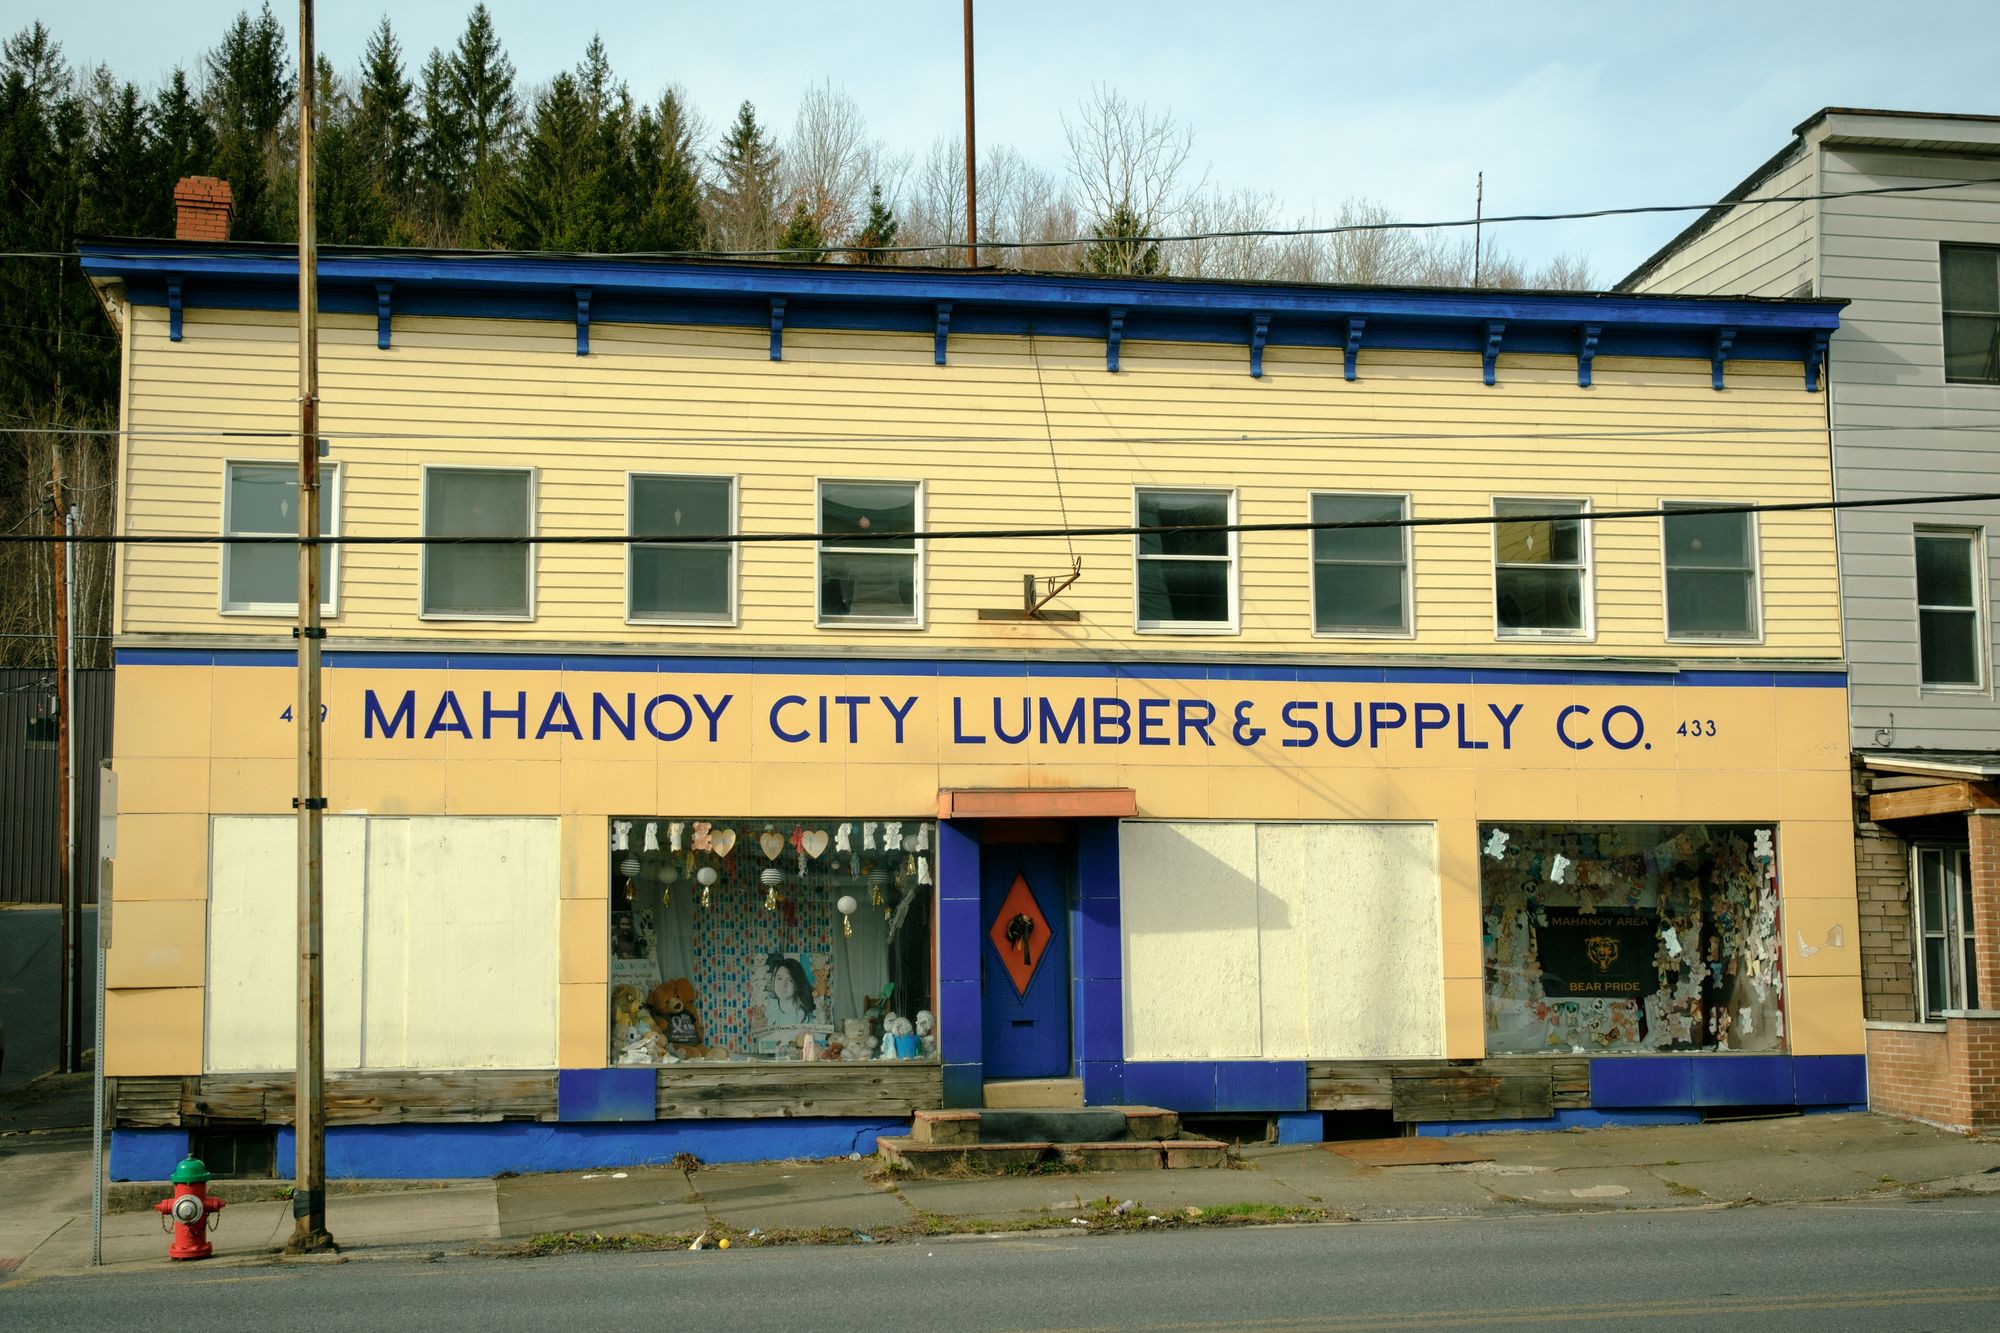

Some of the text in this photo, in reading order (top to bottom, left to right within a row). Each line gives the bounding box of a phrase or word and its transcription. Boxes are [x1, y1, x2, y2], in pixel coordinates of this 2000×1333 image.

[279, 703, 328, 723] 49
[363, 689, 1652, 751] MAHANOY CITY LUMBER & SUPPLY CO.
[1676, 719, 1717, 738] 433
[1552, 917, 1649, 926] MAHANOY AREA
[1569, 982, 1640, 991] BEAR PRIDE
